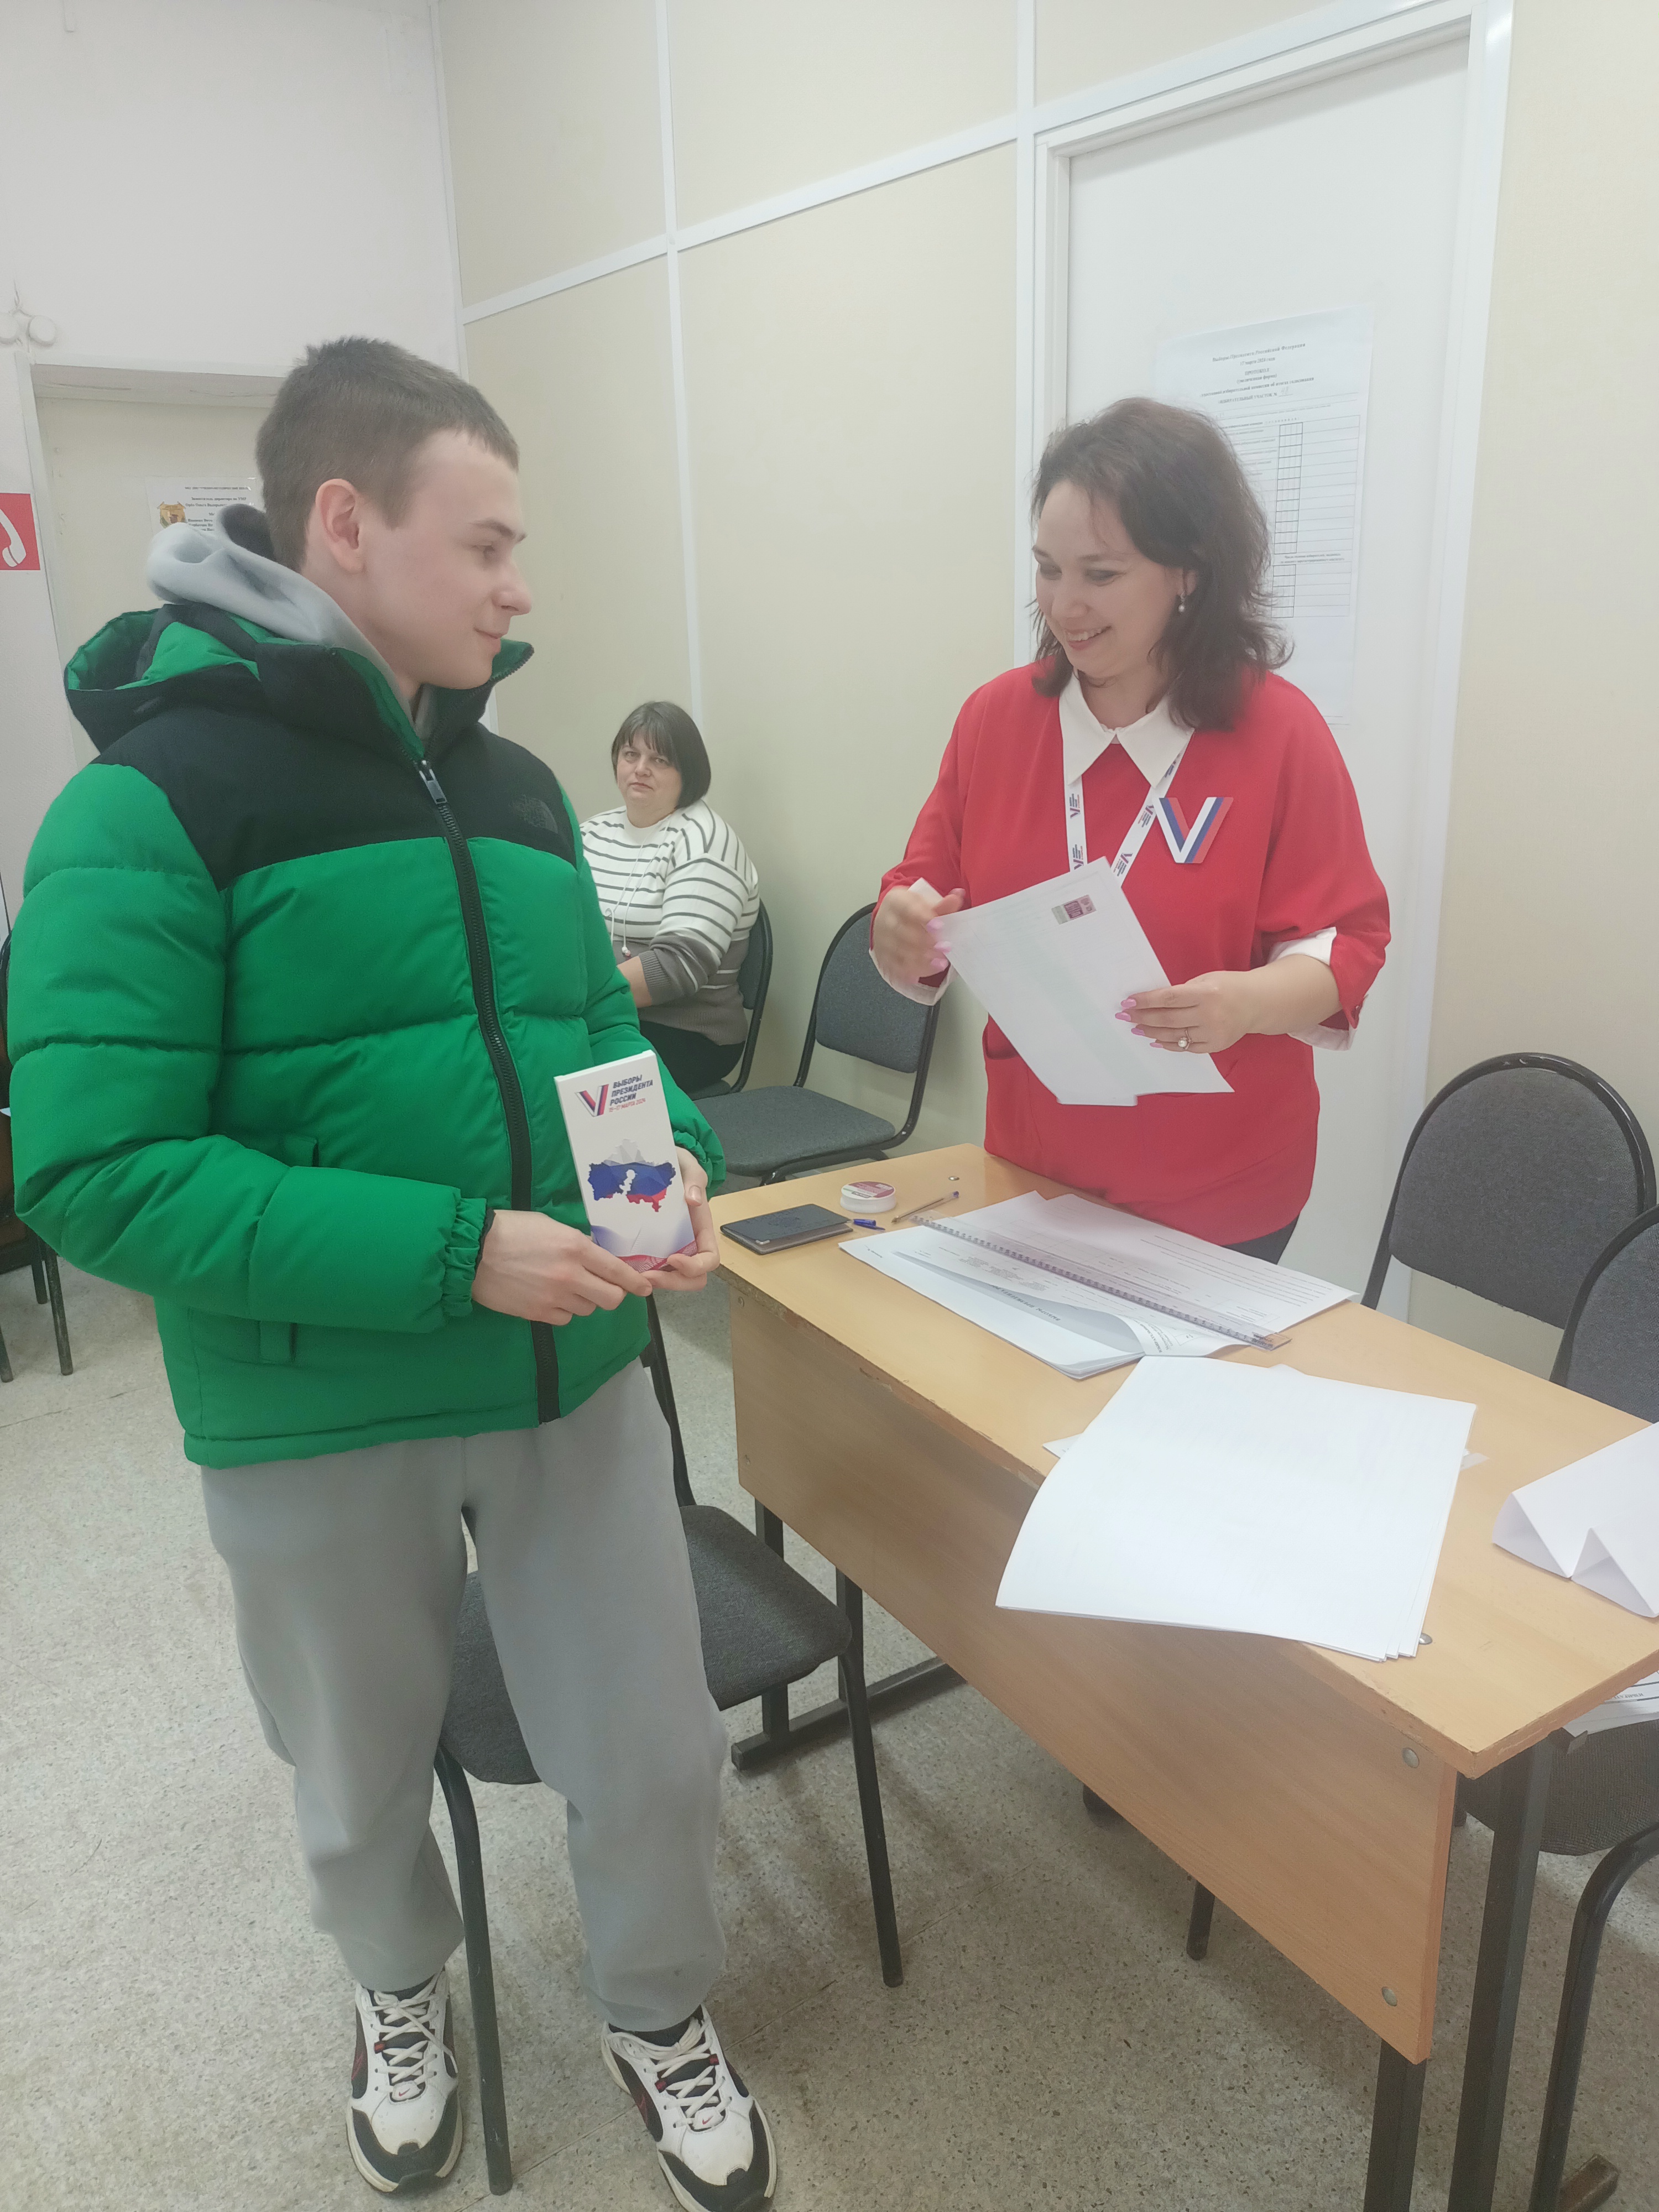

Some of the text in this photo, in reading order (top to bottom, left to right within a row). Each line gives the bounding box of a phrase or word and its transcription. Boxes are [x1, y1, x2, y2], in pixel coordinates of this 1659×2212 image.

[1244, 368, 1270, 376] ПРОТОКОЛ
[611, 1079, 653, 1098] ПРЕЗИДЕНТА
[613, 1074, 643, 1089] ВЫБОРЫ
[609, 1092, 637, 1107] РОССИИ
